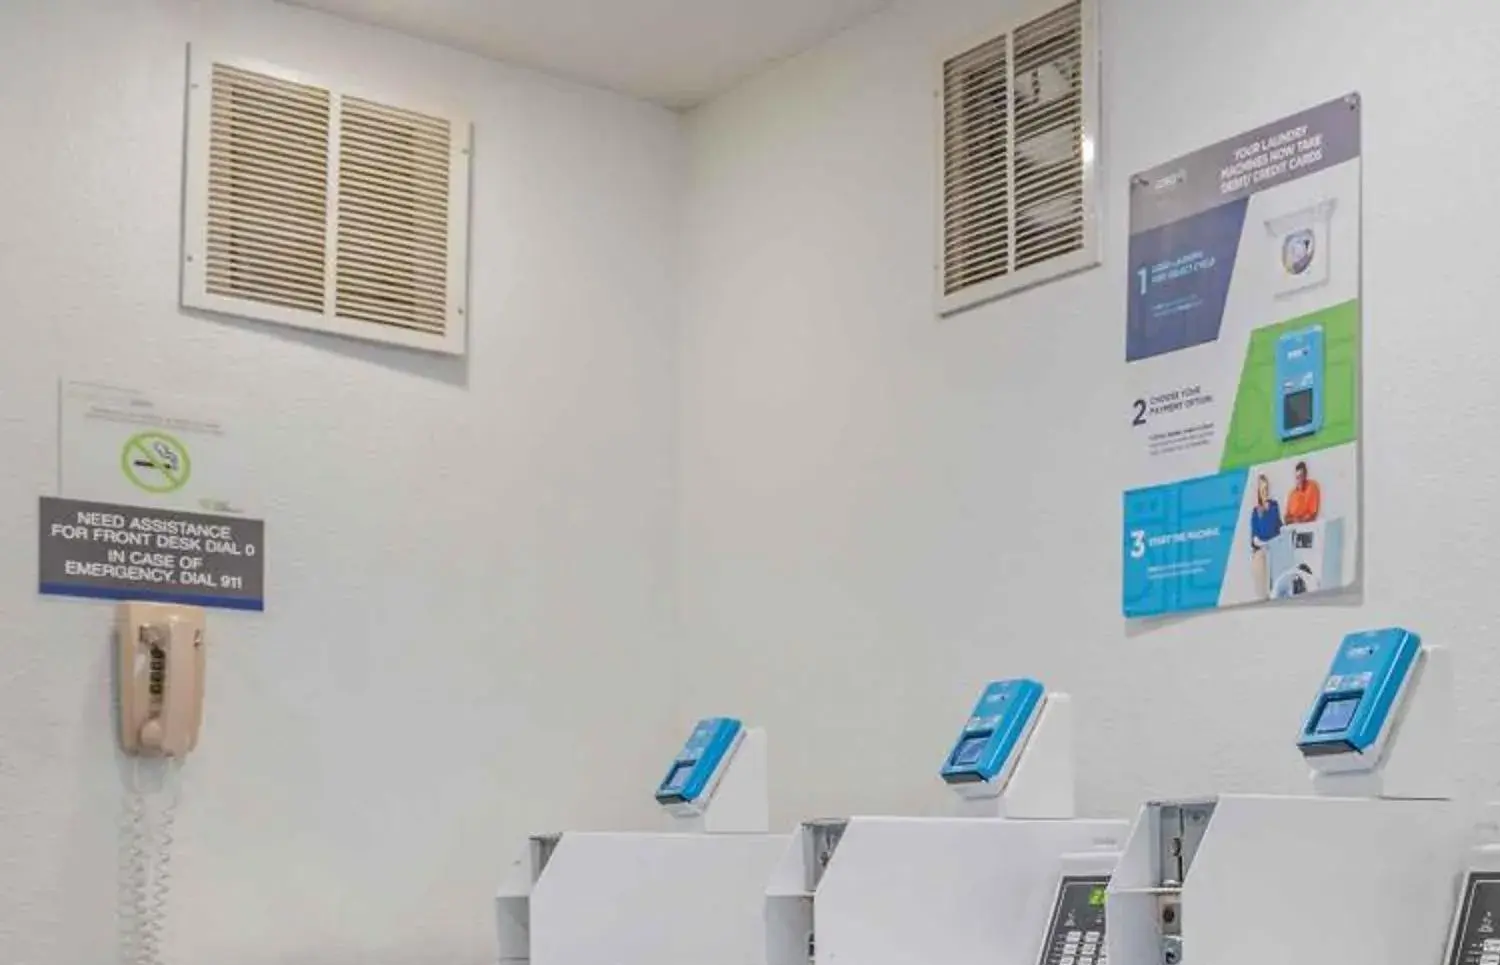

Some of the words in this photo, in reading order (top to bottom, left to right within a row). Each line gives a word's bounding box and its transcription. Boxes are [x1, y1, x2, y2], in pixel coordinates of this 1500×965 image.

[1137, 267, 1147, 295] 1
[1132, 399, 1146, 426] 2
[77, 512, 124, 527] NEED
[129, 517, 231, 539] ASSISTANCE
[51, 524, 88, 540] FOR
[94, 528, 150, 546] FRONT
[156, 535, 201, 551] DESK
[206, 540, 240, 555] DIAL
[1130, 530, 1145, 558] 3
[108, 550, 125, 564] IN
[130, 551, 174, 568] CASE
[180, 557, 202, 570] OF
[180, 573, 216, 588] DIAL
